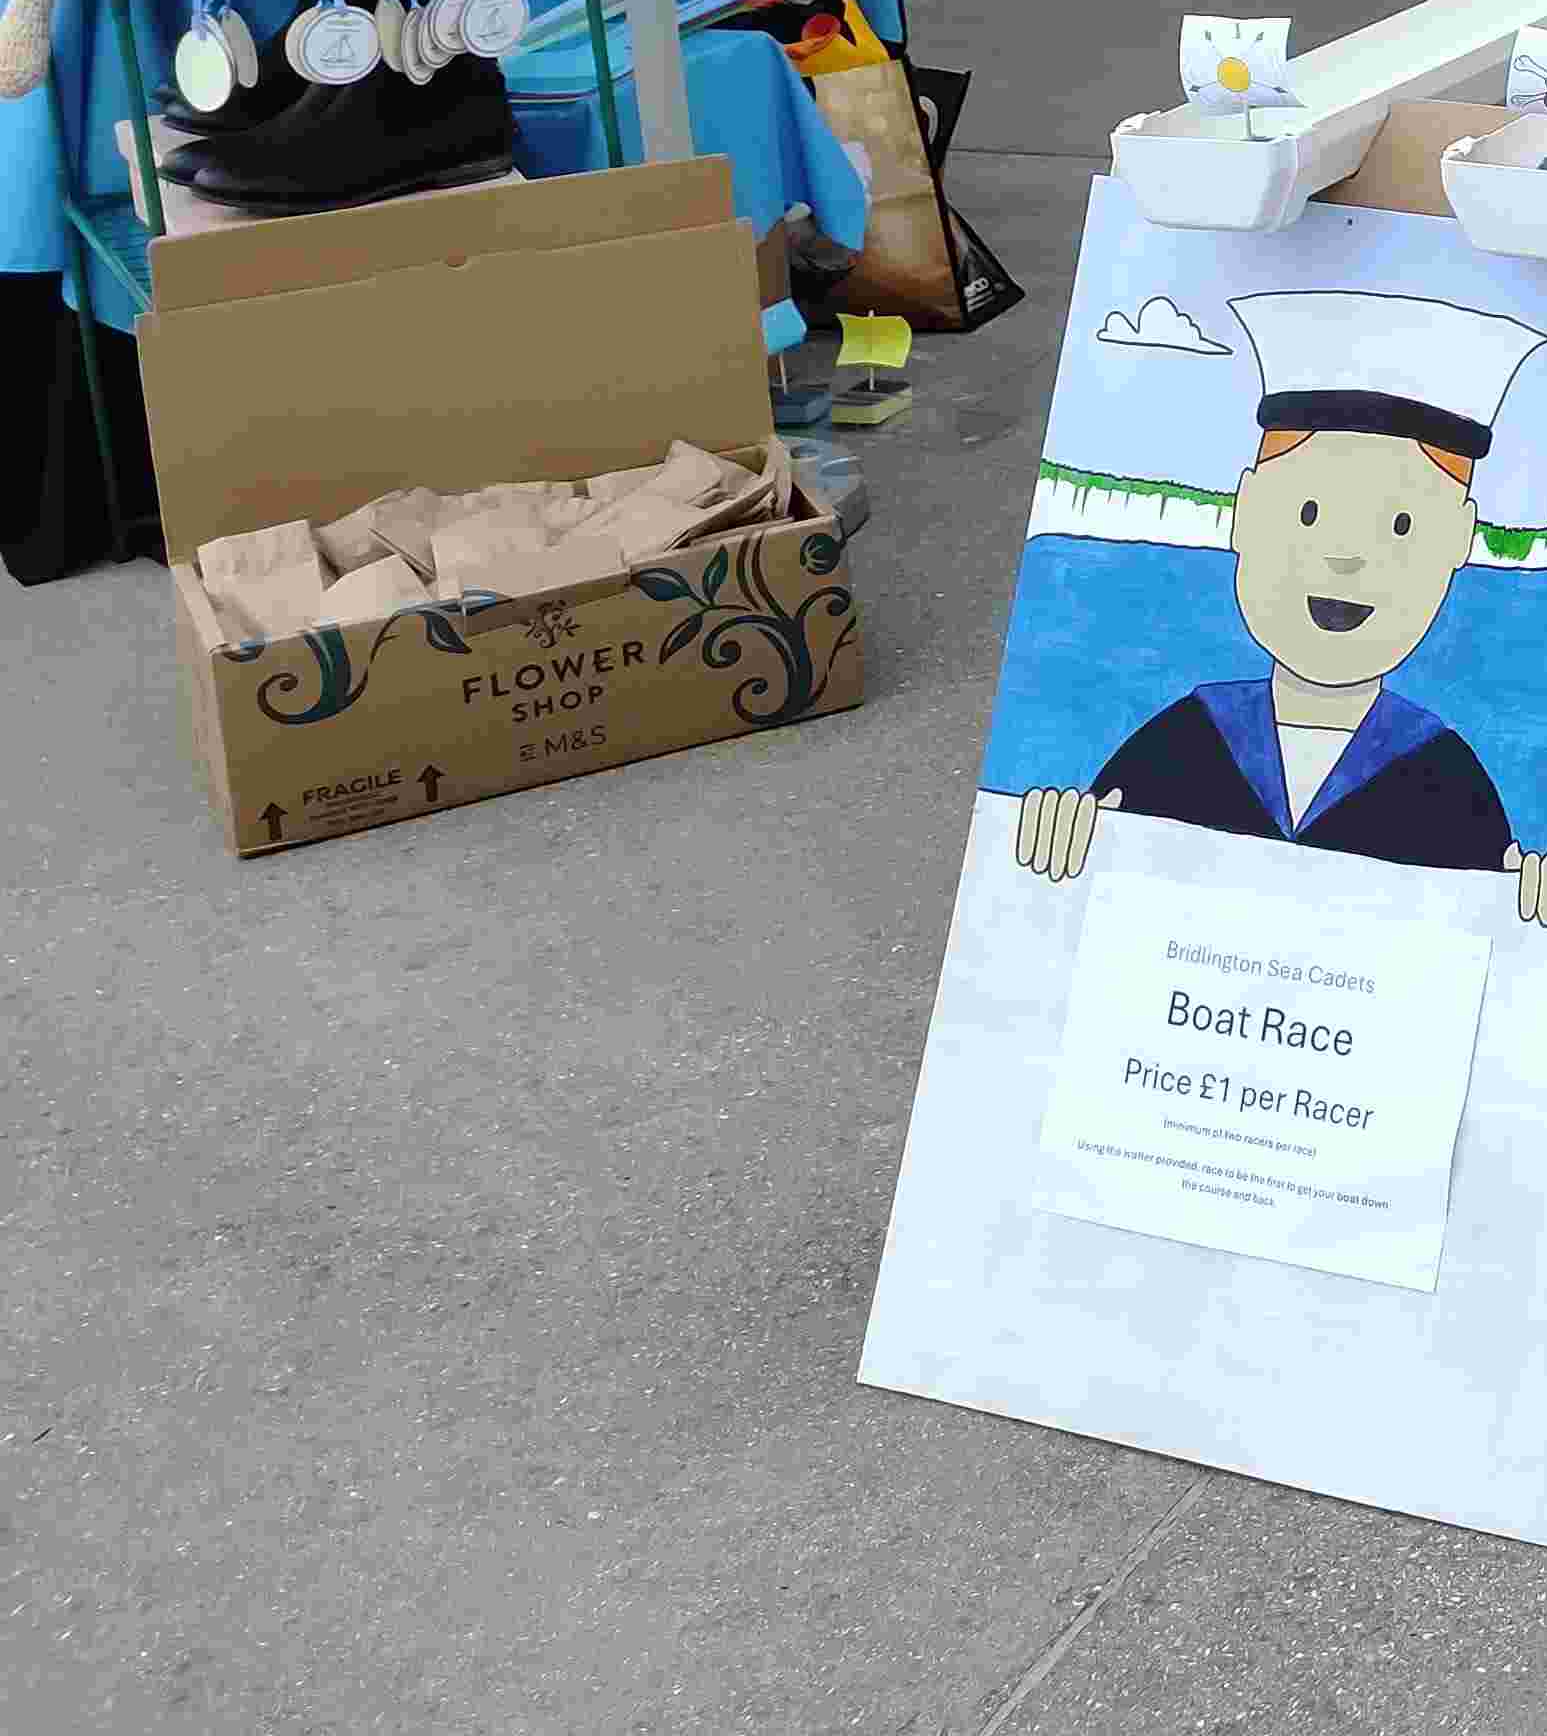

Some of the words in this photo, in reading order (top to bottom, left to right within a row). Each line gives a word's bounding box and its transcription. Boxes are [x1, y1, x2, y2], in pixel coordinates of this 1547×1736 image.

[462, 641, 644, 704] FLOWER
[512, 686, 603, 723] SHOP
[544, 725, 607, 757] M&S
[303, 768, 404, 806] FRAGILE
[1167, 940, 1262, 974] Bridlington
[1267, 959, 1302, 982] Sea
[1308, 965, 1376, 994] Cadets
[1168, 990, 1252, 1039] Boat
[1261, 1006, 1353, 1056] Race
[1124, 1057, 1192, 1095] Price
[1199, 1073, 1231, 1103] £1
[1239, 1086, 1288, 1112] per
[1293, 1089, 1375, 1130] Racer
